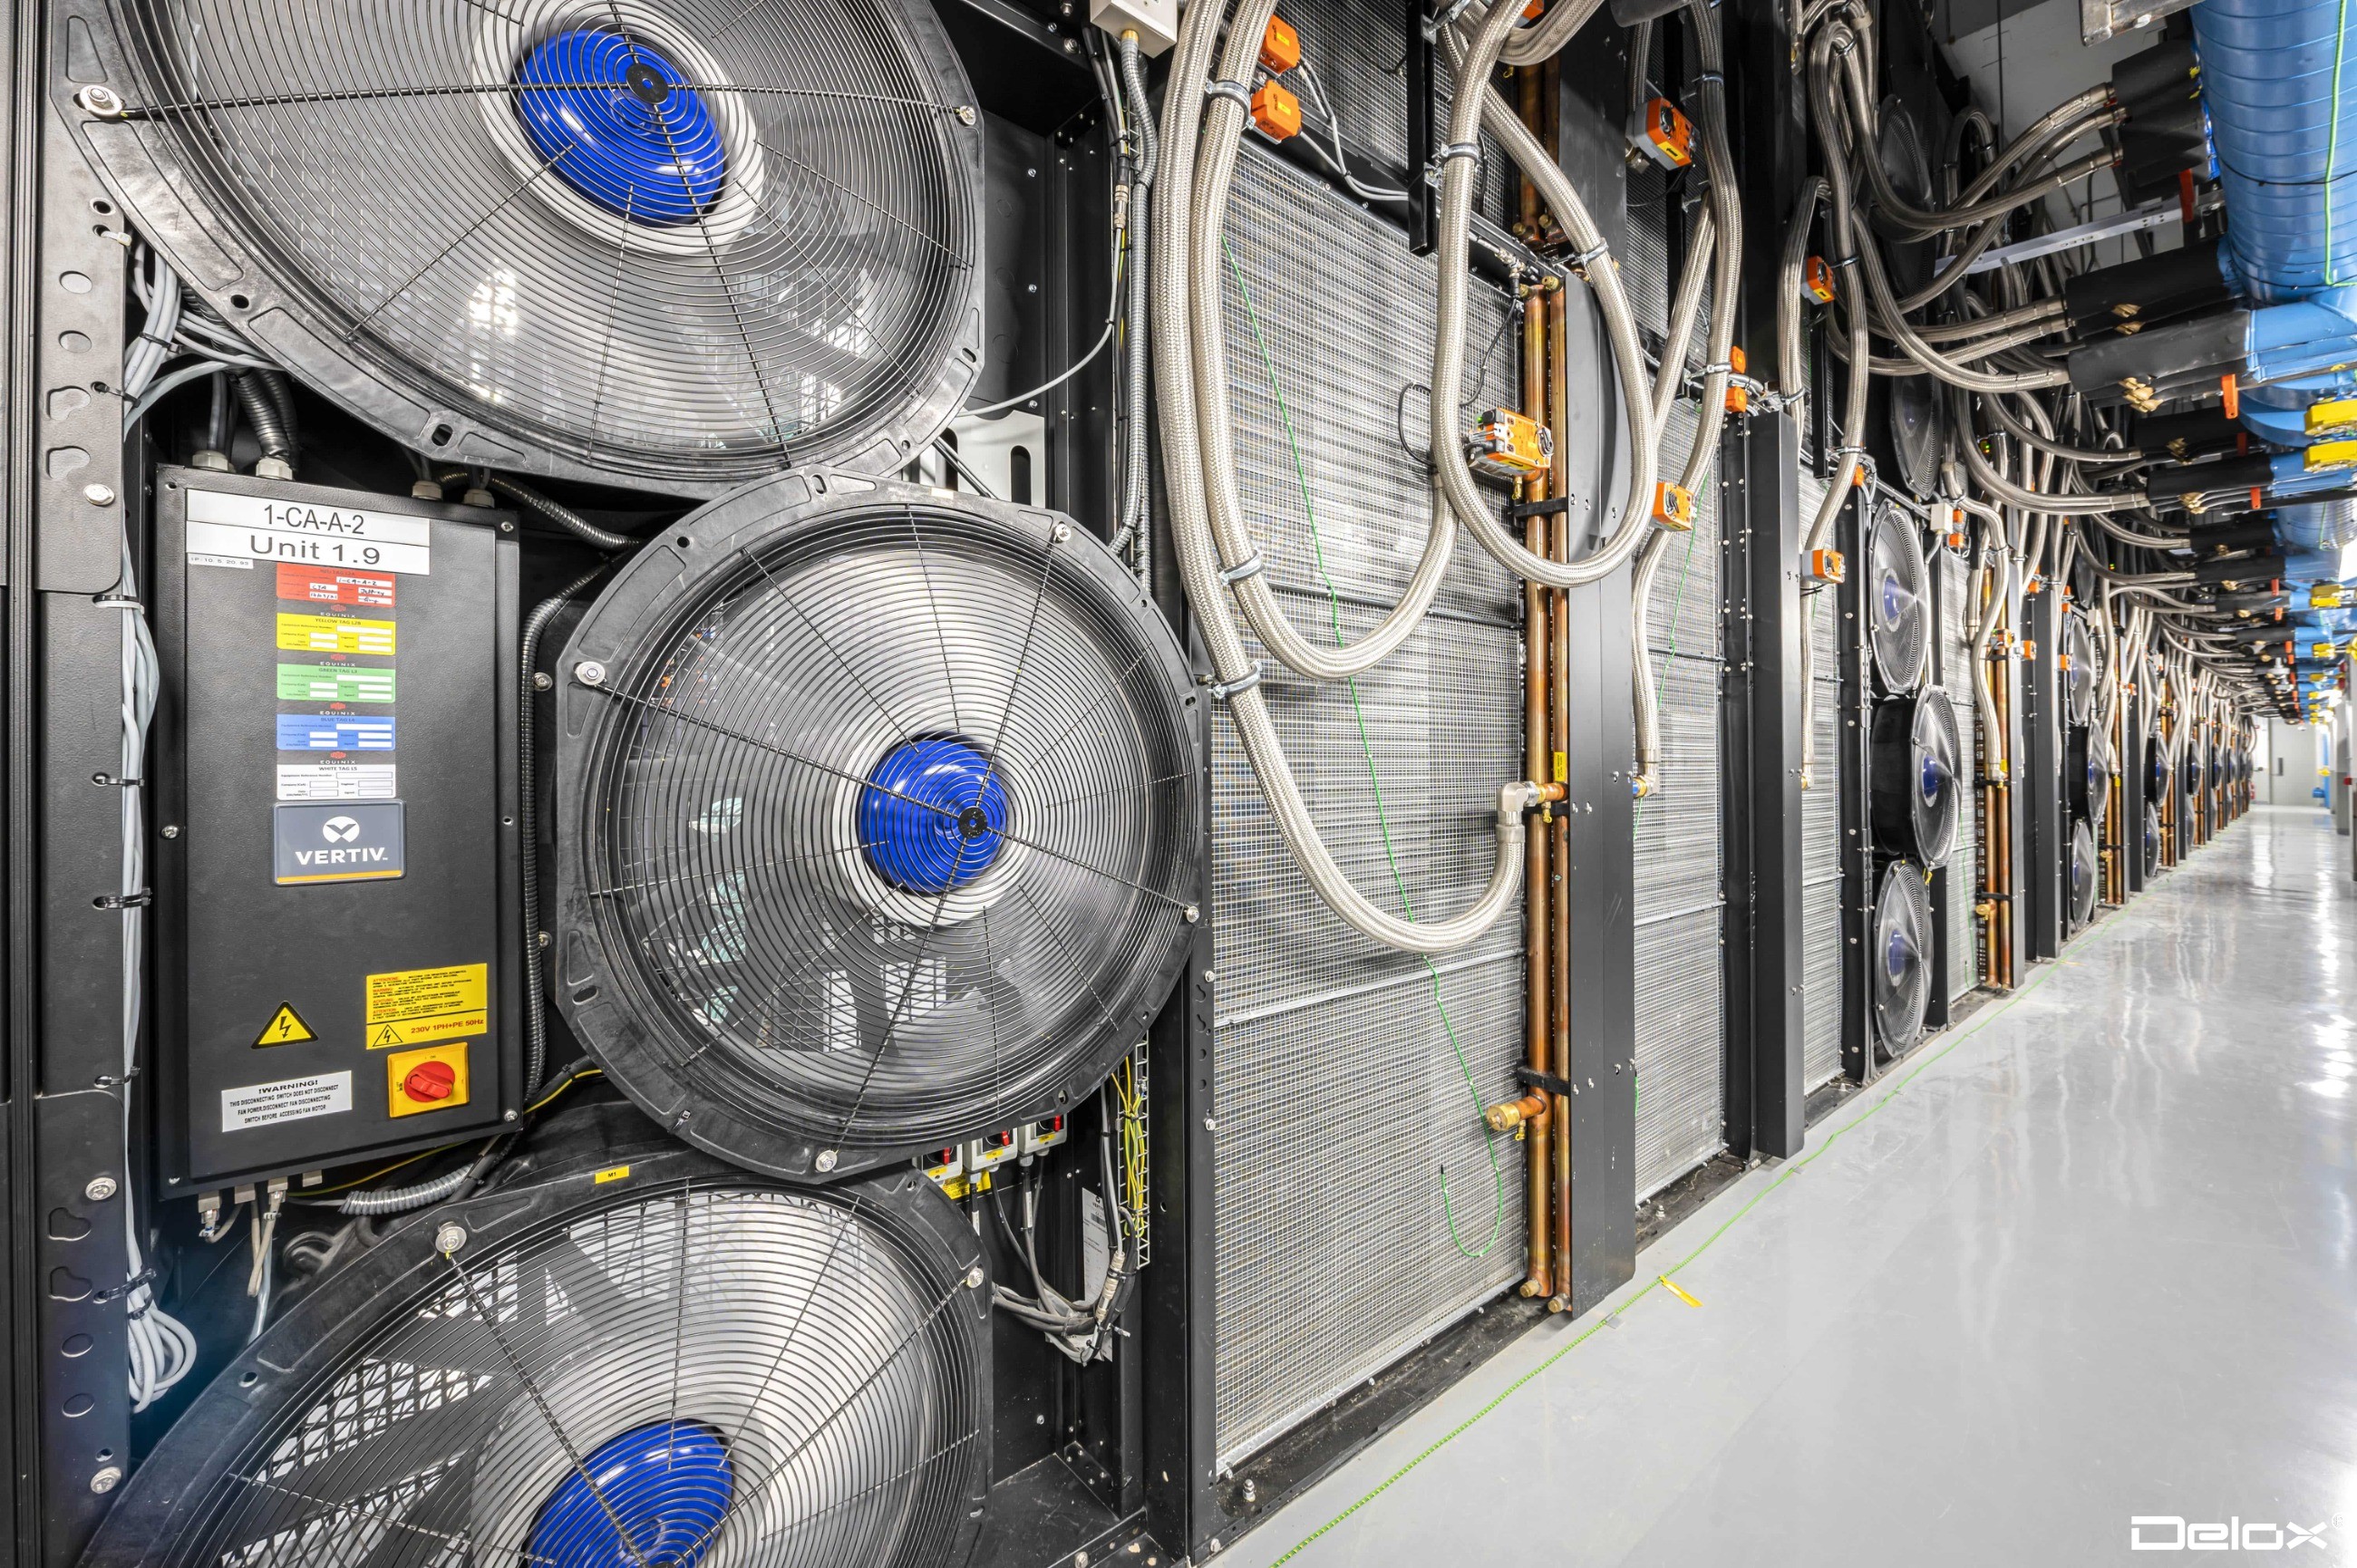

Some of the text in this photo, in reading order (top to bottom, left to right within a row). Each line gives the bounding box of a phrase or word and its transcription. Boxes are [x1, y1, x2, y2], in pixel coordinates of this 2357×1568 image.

[264, 504, 364, 535] 1-CA-A-2
[250, 535, 381, 566] Unit 1.9
[432, 1021, 463, 1030] 1PH+PE
[258, 1079, 318, 1094] !WARNING!
[241, 1095, 275, 1105] DISCONNECTING
[314, 1084, 339, 1094] DISCONNECT
[298, 1095, 331, 1105] DISCONNECTING
[279, 1108, 302, 1118] ACCESSING
